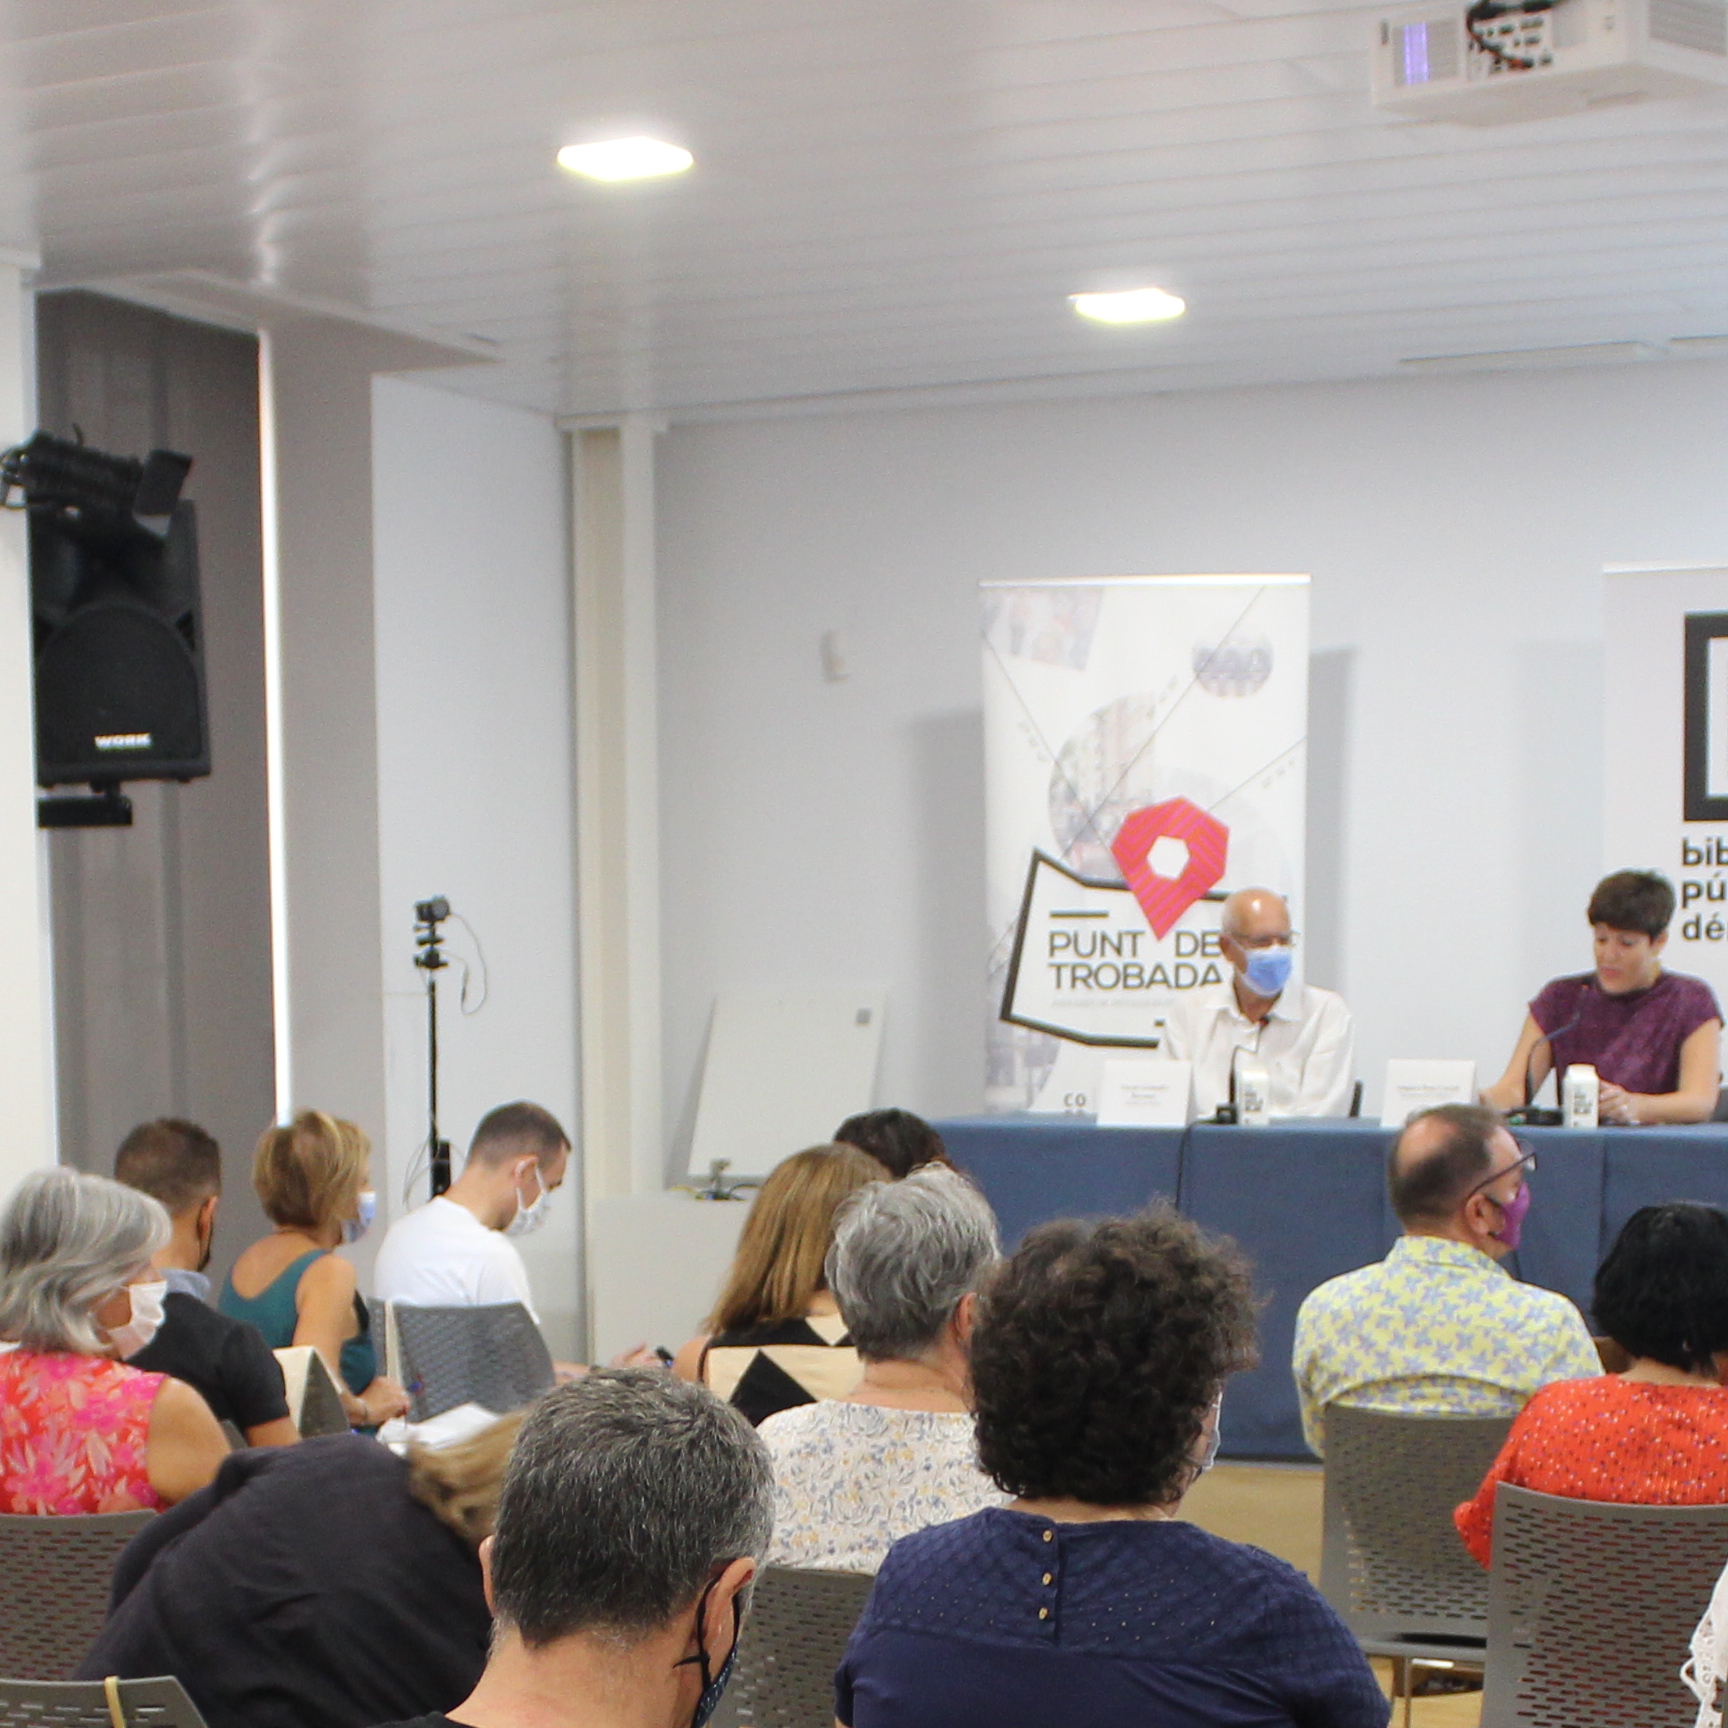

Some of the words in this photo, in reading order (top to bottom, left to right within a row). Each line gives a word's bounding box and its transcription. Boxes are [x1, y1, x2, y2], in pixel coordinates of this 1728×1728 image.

[94, 732, 152, 749] WORK
[1049, 930, 1145, 957] PUNT
[1175, 929, 1221, 958] DE
[1048, 961, 1222, 990] TROBADA
